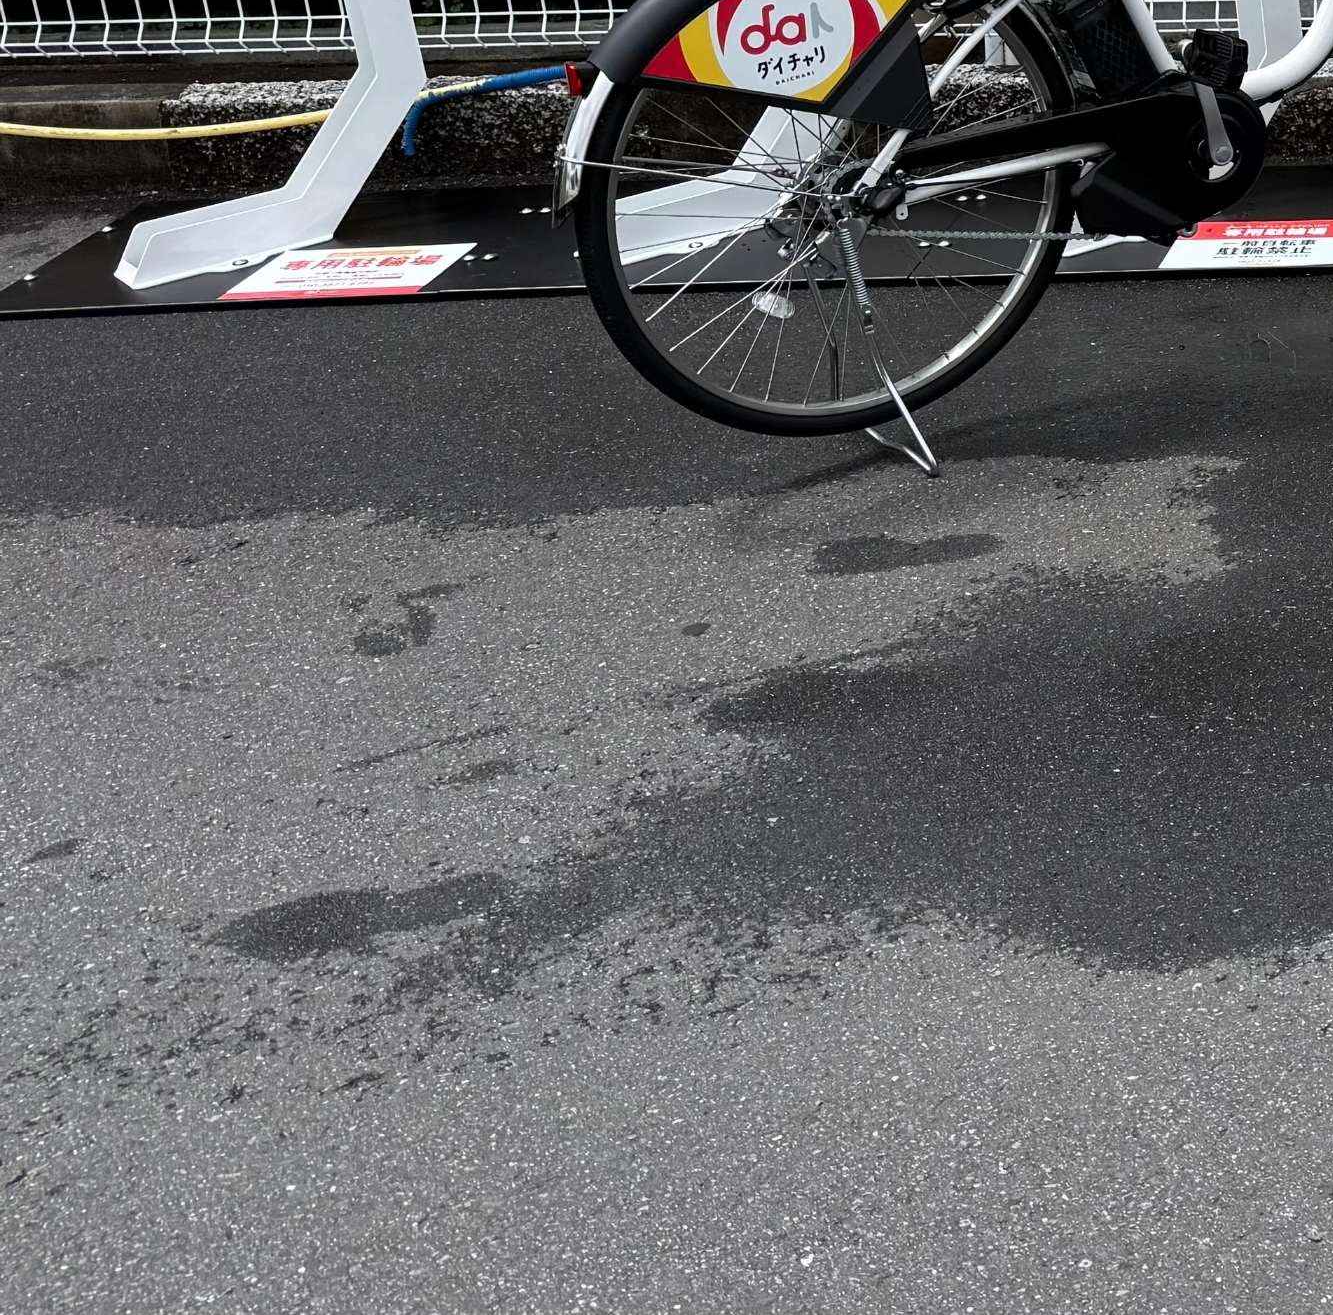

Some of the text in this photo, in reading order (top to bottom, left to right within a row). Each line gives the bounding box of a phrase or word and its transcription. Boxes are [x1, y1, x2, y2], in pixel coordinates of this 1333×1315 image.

[757, 46, 826, 79] ダイチャリ
